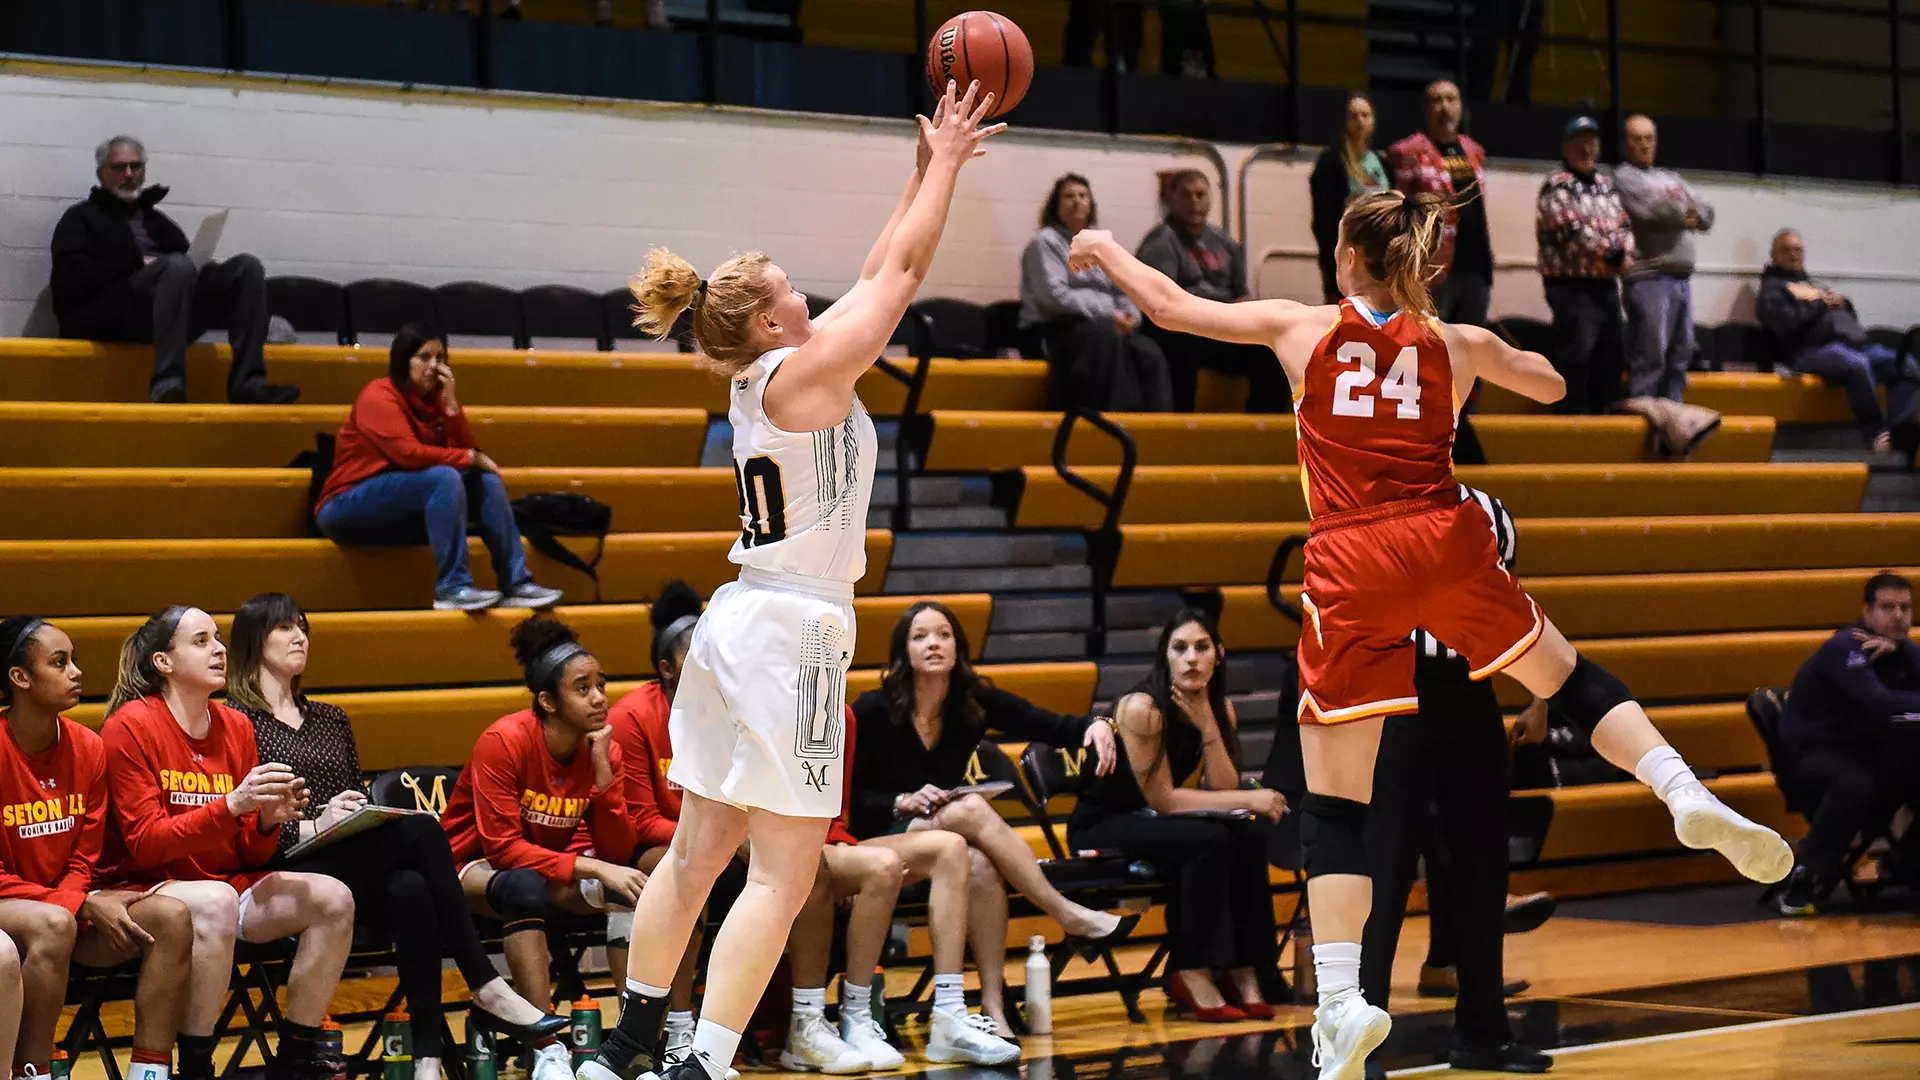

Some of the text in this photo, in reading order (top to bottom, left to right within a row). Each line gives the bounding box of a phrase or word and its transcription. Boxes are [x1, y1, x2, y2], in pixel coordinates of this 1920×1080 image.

[940, 25, 961, 97] Wilso
[1332, 341, 1421, 420] 24
[160, 769, 234, 794] SETON HI
[3, 798, 63, 827] SETON
[520, 788, 562, 816] ETON
